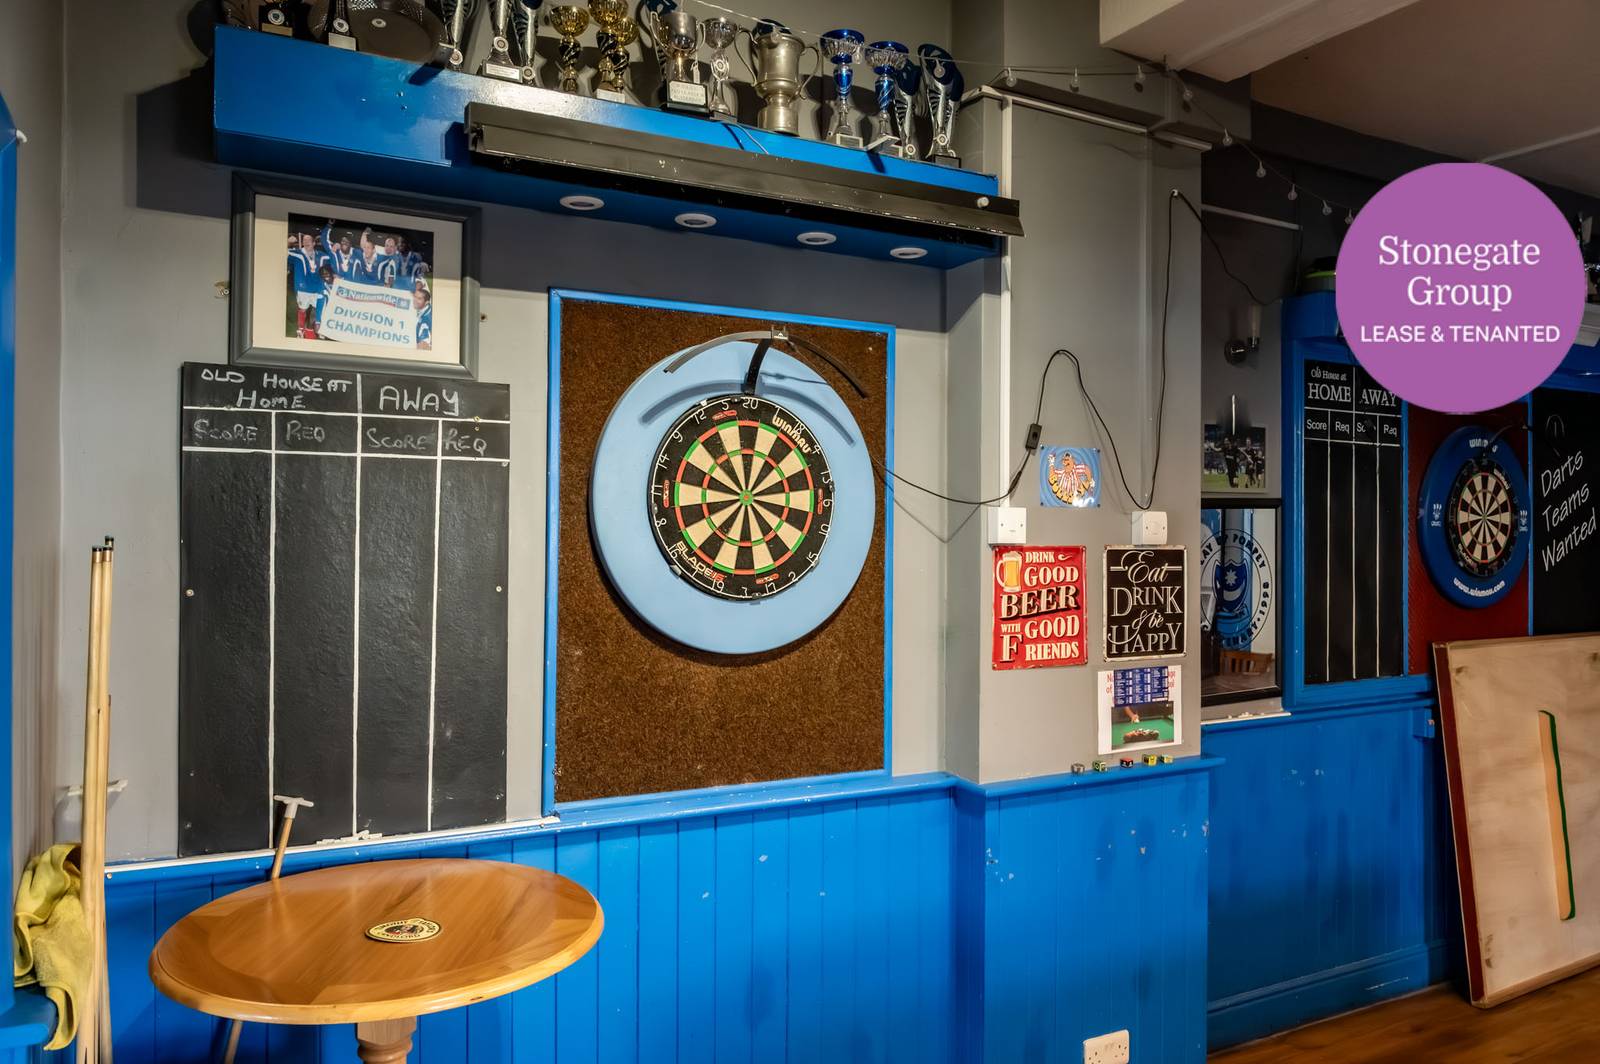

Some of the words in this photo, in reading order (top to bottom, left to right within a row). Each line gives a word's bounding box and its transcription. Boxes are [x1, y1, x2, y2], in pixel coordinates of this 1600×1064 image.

[334, 306, 394, 327] DIVISION
[398, 320, 405, 330] 1
[326, 319, 410, 344] CHAMPIONS
[201, 368, 245, 383] OLD
[379, 386, 459, 416] AWAY
[742, 398, 759, 410] 20
[1307, 383, 1351, 402] HOME
[1361, 389, 1397, 407] AWAY
[694, 409, 708, 425] 12
[1306, 419, 1327, 431] Score
[1335, 421, 1350, 434] Req
[193, 418, 258, 441] SCORE
[286, 419, 326, 443] REQ
[366, 427, 428, 450] SCORE
[445, 428, 488, 452] REQ
[657, 453, 670, 469] 14
[1541, 451, 1583, 497] Darts
[1542, 483, 1589, 532] Teams
[1232, 533, 1267, 569] POMPEY
[1541, 507, 1596, 572] Wanted
[1025, 551, 1055, 563] DRINK
[1120, 550, 1168, 584] Eat
[1024, 566, 1079, 587] GOOD
[1000, 584, 1078, 620] BEER
[1111, 586, 1183, 617] DRINK
[1001, 623, 1021, 633] WITH
[1024, 615, 1080, 639] GOOD
[1149, 613, 1163, 629] be
[1109, 622, 1182, 654] HAPPY
